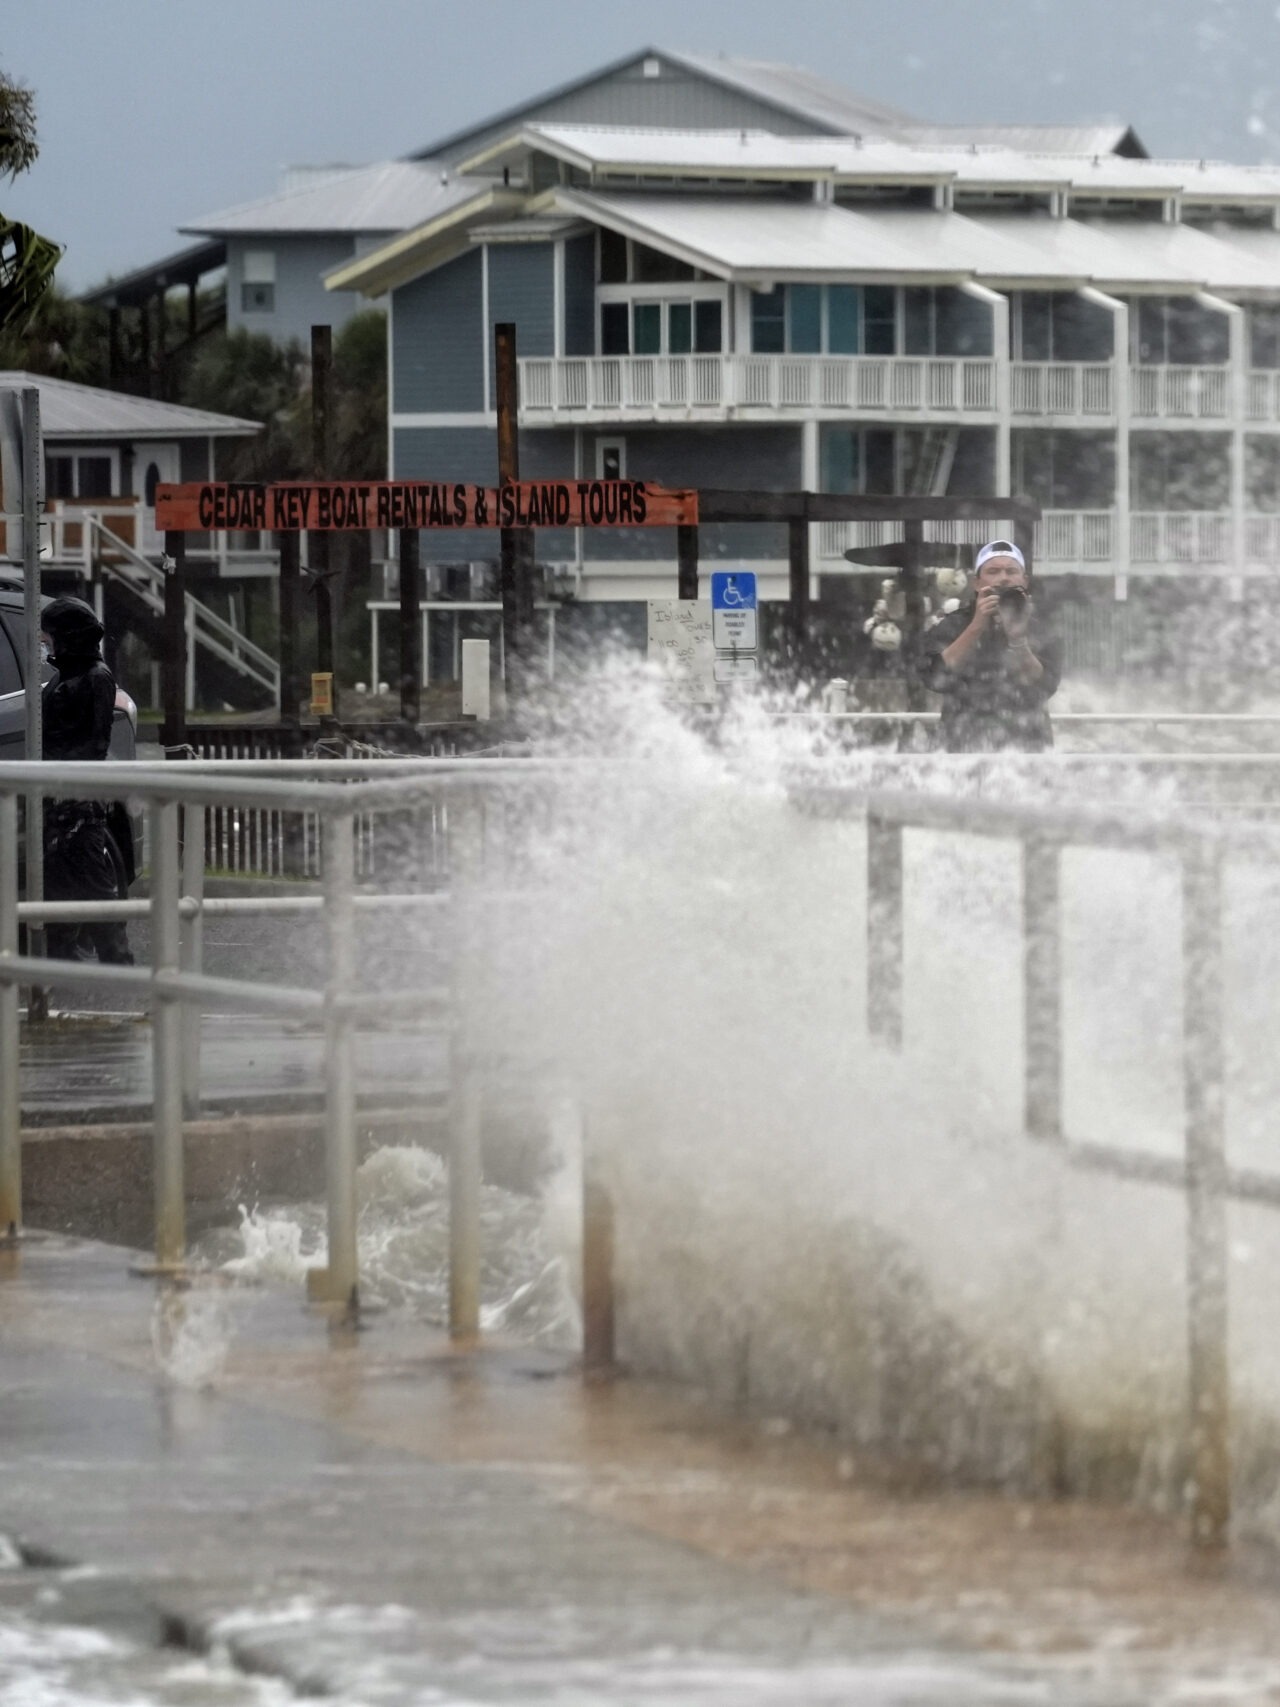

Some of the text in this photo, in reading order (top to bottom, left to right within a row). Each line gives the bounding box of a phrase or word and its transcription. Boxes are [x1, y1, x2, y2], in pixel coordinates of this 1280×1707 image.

[199, 481, 647, 528] CEDAR KEY BOAT RENTALS & ISLAND TOURS
